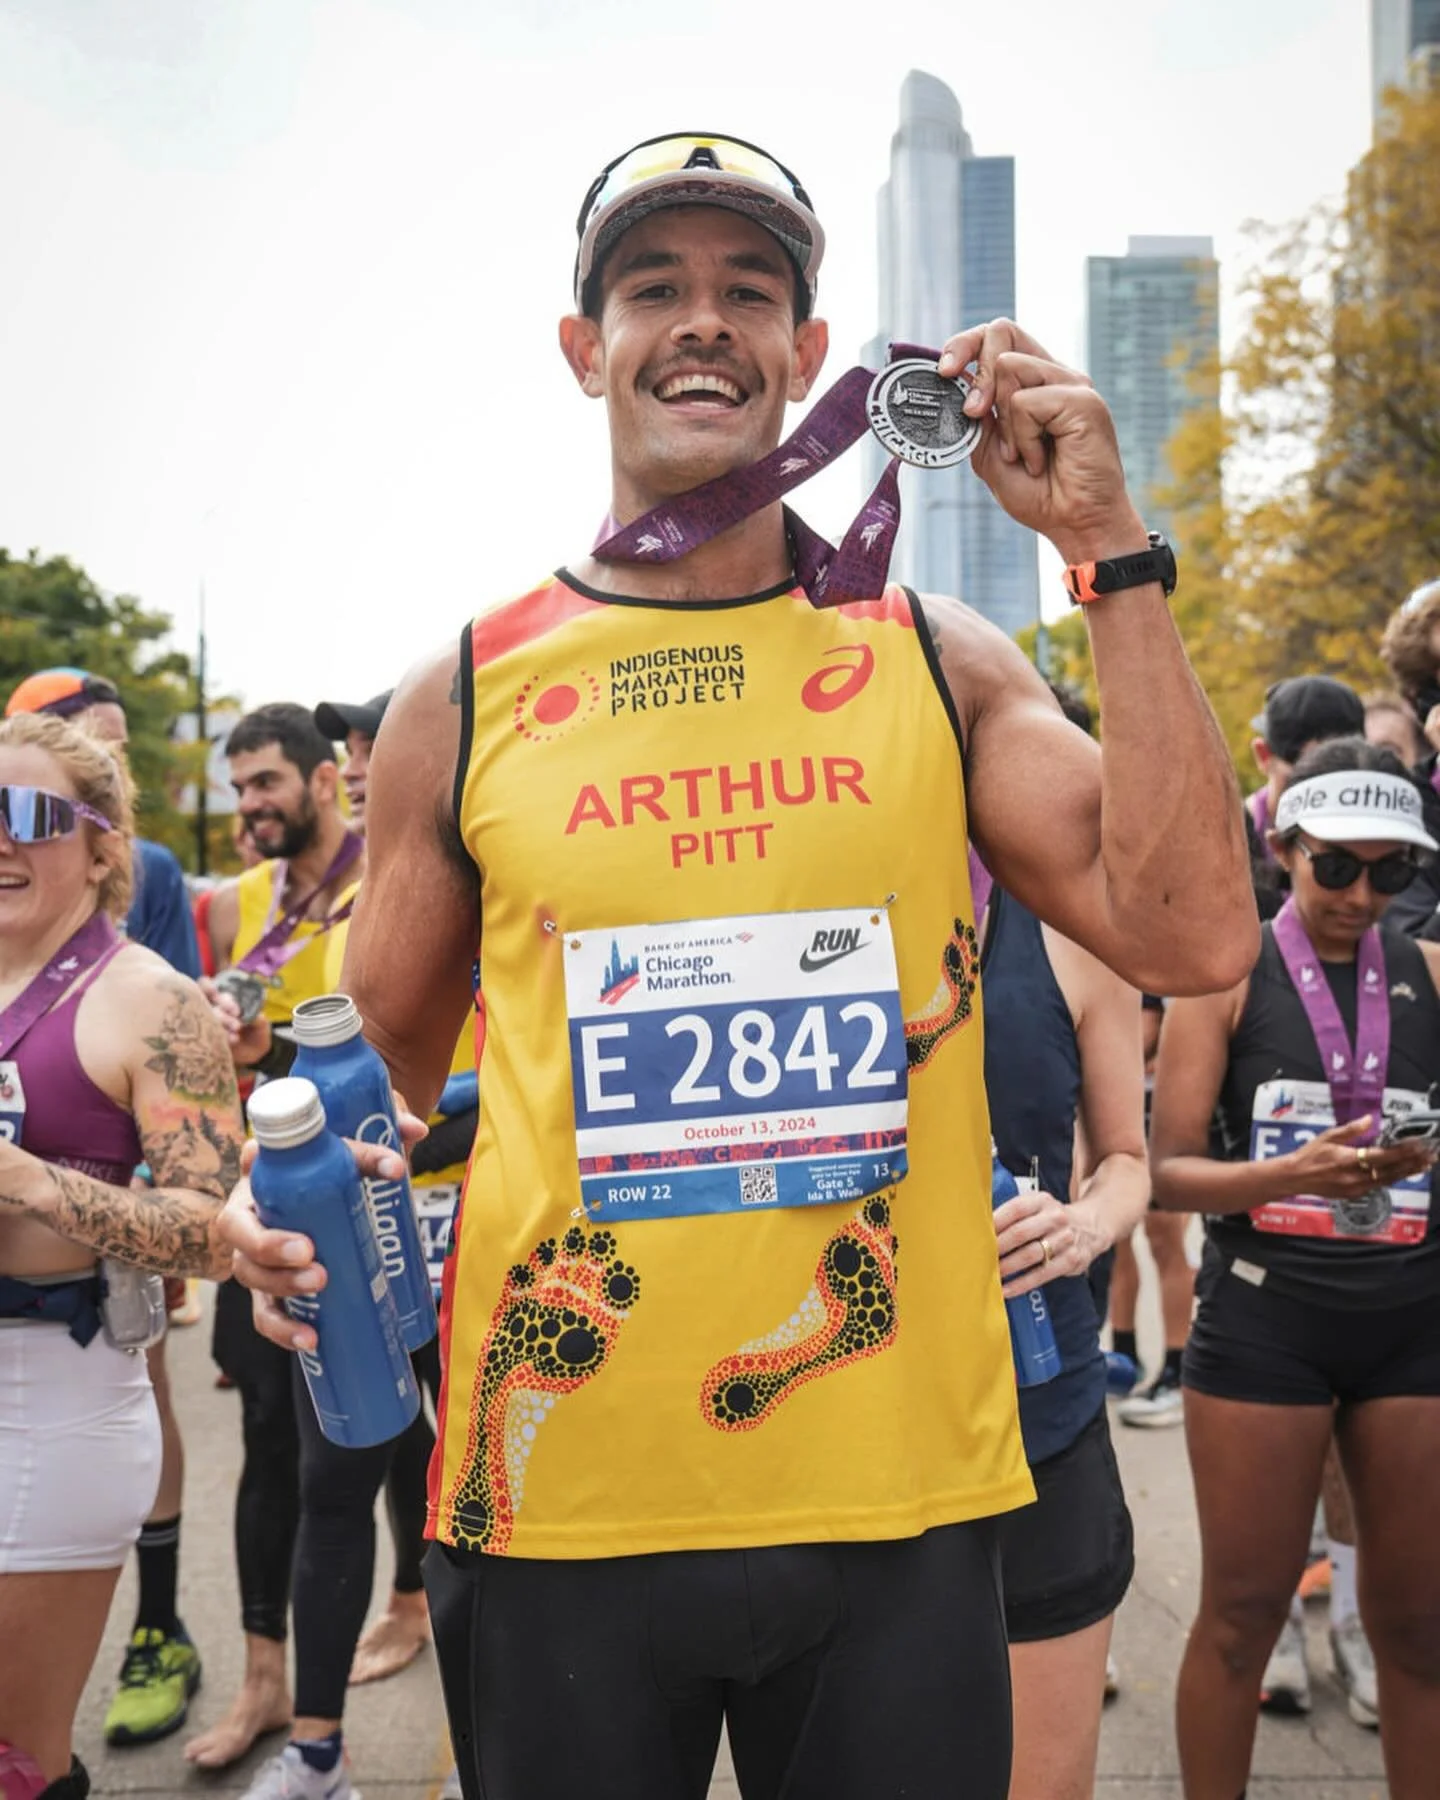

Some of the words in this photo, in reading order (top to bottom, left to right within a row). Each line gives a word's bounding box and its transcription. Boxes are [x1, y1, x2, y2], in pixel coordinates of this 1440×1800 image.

[610, 644, 744, 679] INDIGENOUS
[611, 664, 746, 698] MARATHON
[611, 682, 746, 717] PROJECT
[564, 756, 872, 836] ARTHUR
[671, 823, 774, 869] PITT
[644, 943, 672, 953] BANK
[674, 941, 685, 950] OF
[688, 936, 733, 949] AMERICA
[812, 928, 861, 952] RUN
[646, 955, 714, 973] Chicago
[580, 1022, 636, 1113] E
[664, 1000, 897, 1105] 2842
[683, 1123, 745, 1141] October
[751, 1119, 774, 1136] 13,
[778, 1116, 817, 1133] 2024
[873, 1162, 889, 1178] 13
[608, 1186, 647, 1204] ROW
[651, 1184, 673, 1201] 22
[816, 1178, 843, 1190] Gate
[847, 1176, 855, 1188] 5
